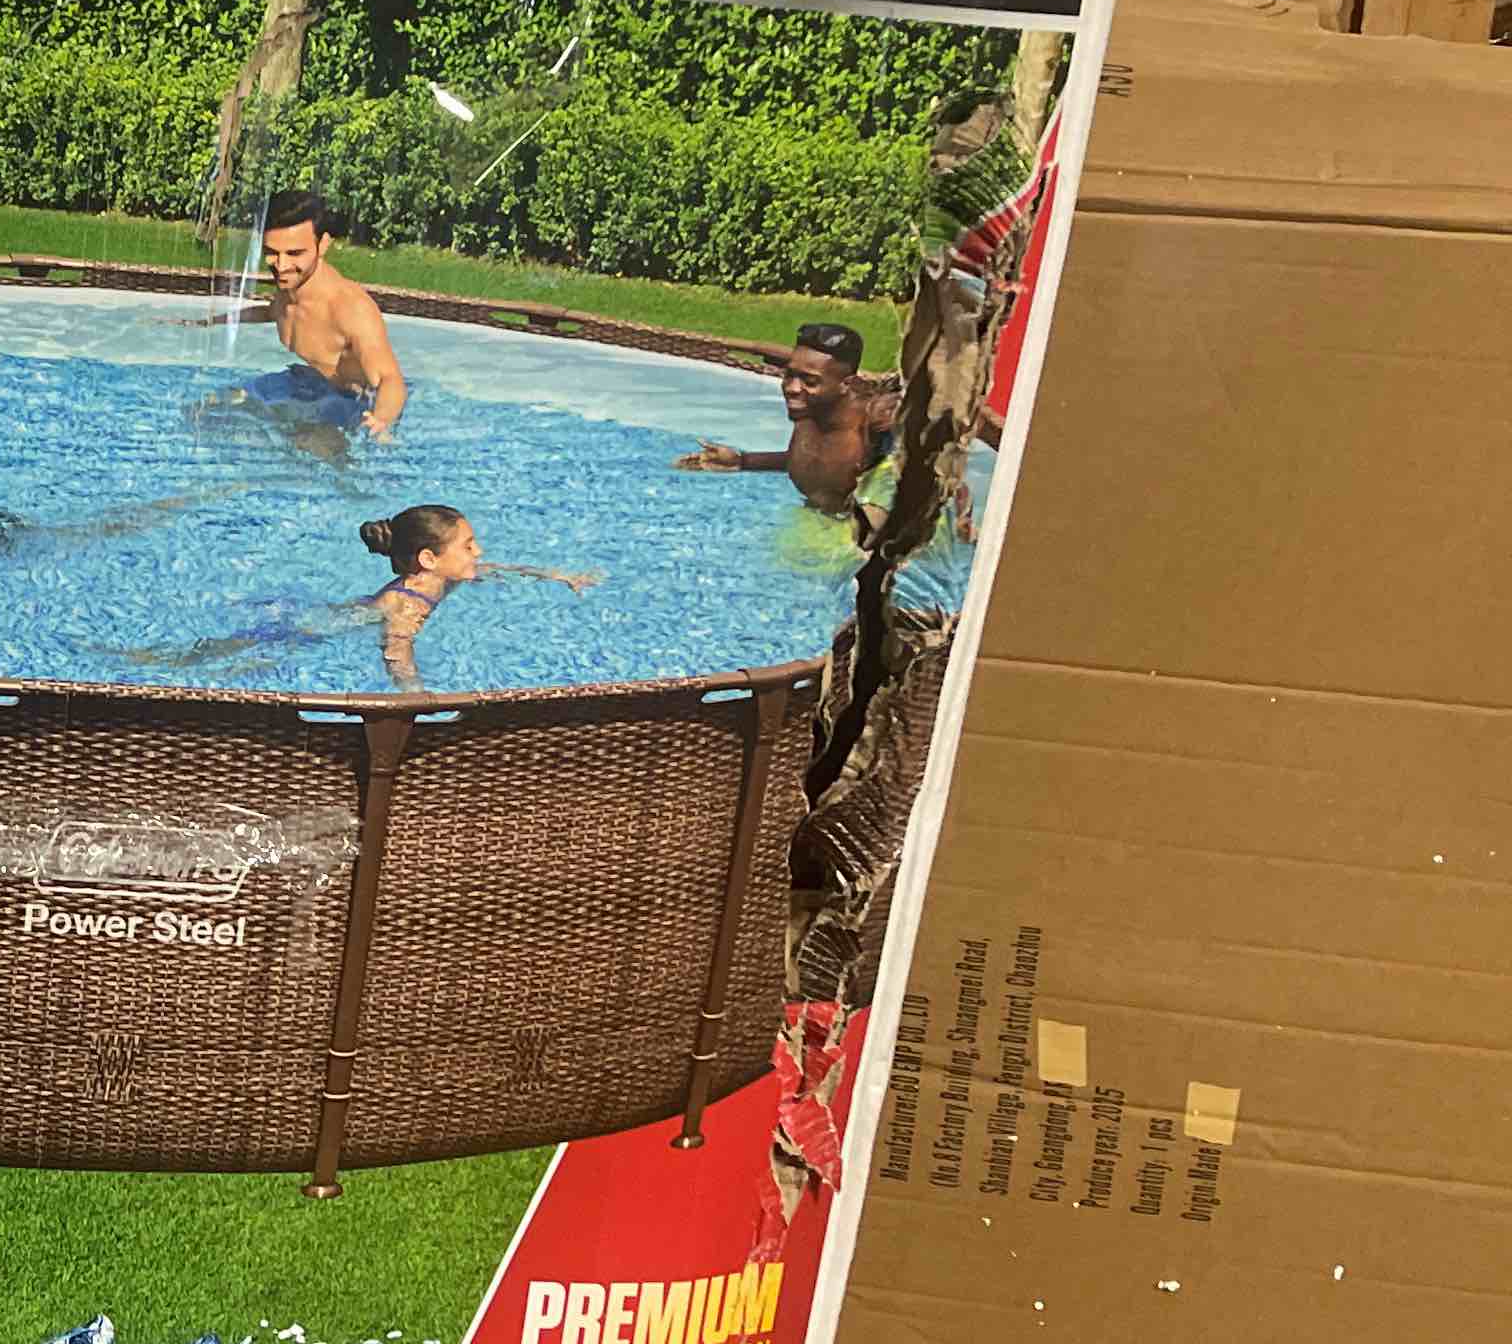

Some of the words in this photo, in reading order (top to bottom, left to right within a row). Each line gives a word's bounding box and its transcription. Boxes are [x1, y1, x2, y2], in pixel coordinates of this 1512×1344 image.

[21, 902, 144, 940] Power
[152, 910, 247, 947] Steel
[934, 1102, 973, 1153] Factory
[1094, 1086, 1126, 1124] 2025
[1147, 1117, 1176, 1141] pcs
[1080, 1159, 1116, 1209] Produce
